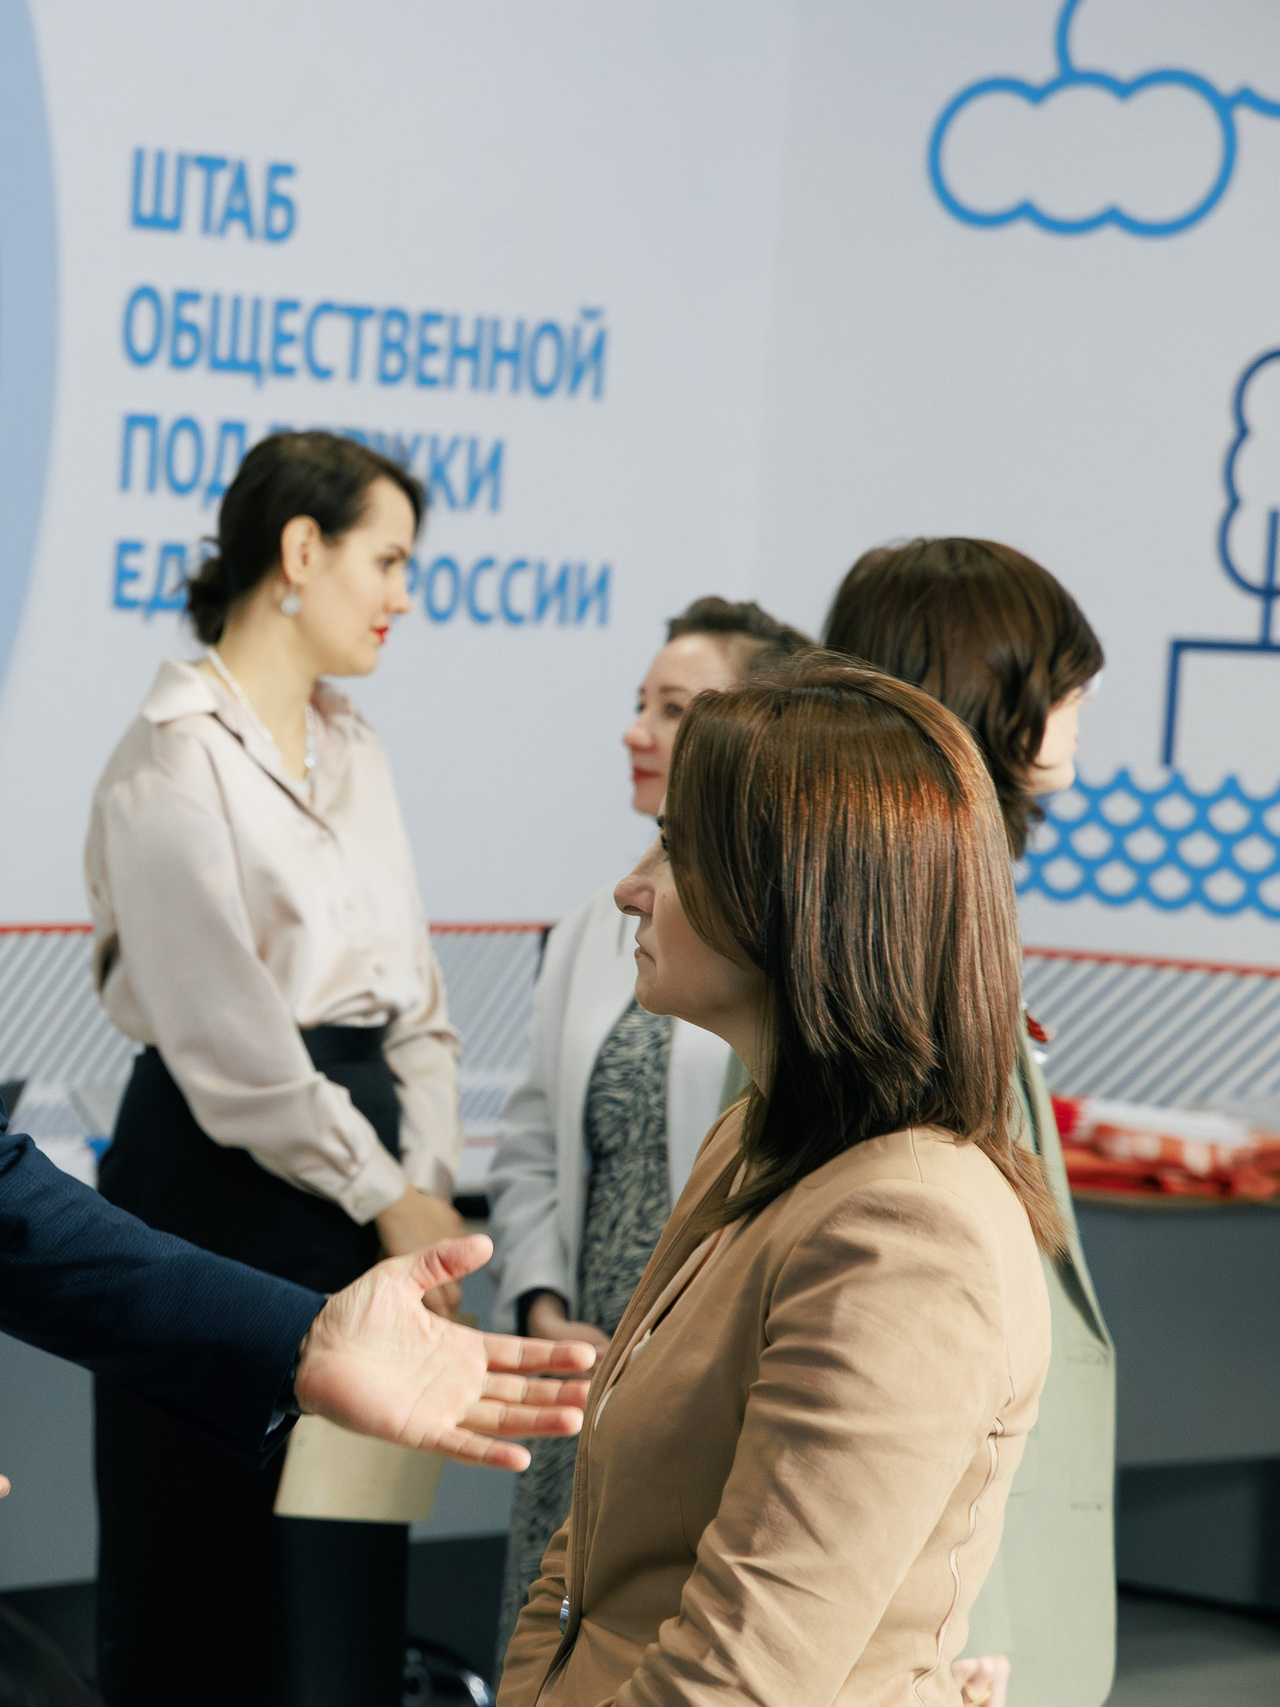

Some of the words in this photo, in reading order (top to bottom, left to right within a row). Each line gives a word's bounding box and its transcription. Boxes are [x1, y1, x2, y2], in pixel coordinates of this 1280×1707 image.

[130, 149, 298, 243] ШТАБ
[123, 285, 608, 400] ОБЩЕСТВЕННОЙ
[120, 413, 505, 513] ПОДКИ
